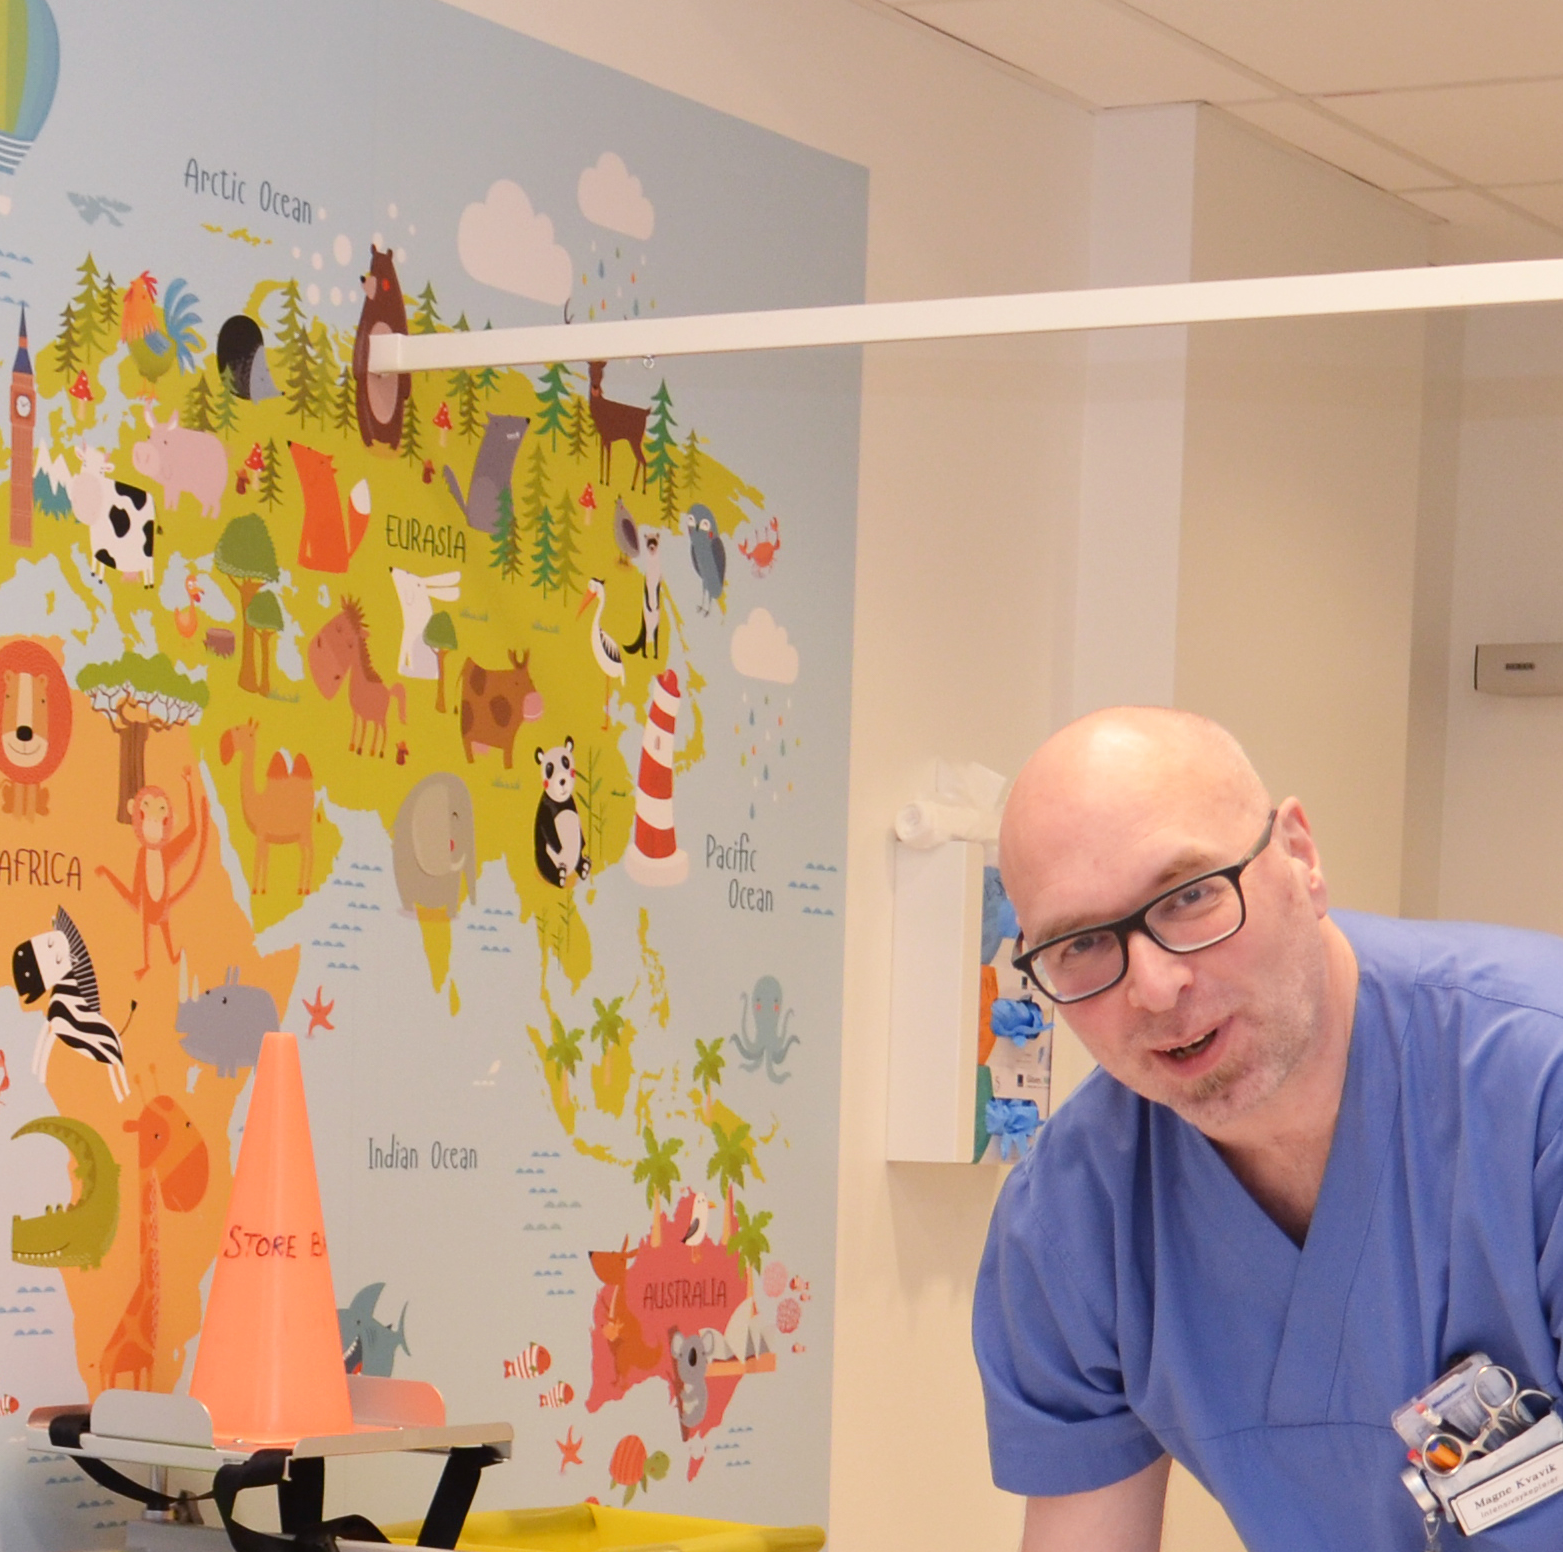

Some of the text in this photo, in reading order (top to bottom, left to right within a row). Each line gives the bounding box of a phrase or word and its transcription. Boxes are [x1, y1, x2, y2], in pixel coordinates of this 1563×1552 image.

[184, 157, 312, 225] Arctic Ocean
[386, 514, 467, 563] EURASIA
[706, 831, 757, 873] Pacific
[728, 878, 774, 913] Ocean
[368, 1133, 478, 1171] Indian Ocean
[223, 1224, 297, 1259] STORE
[642, 1278, 727, 1311] AUSTRALIA
[1474, 1463, 1558, 1511] Magne Kvavik
